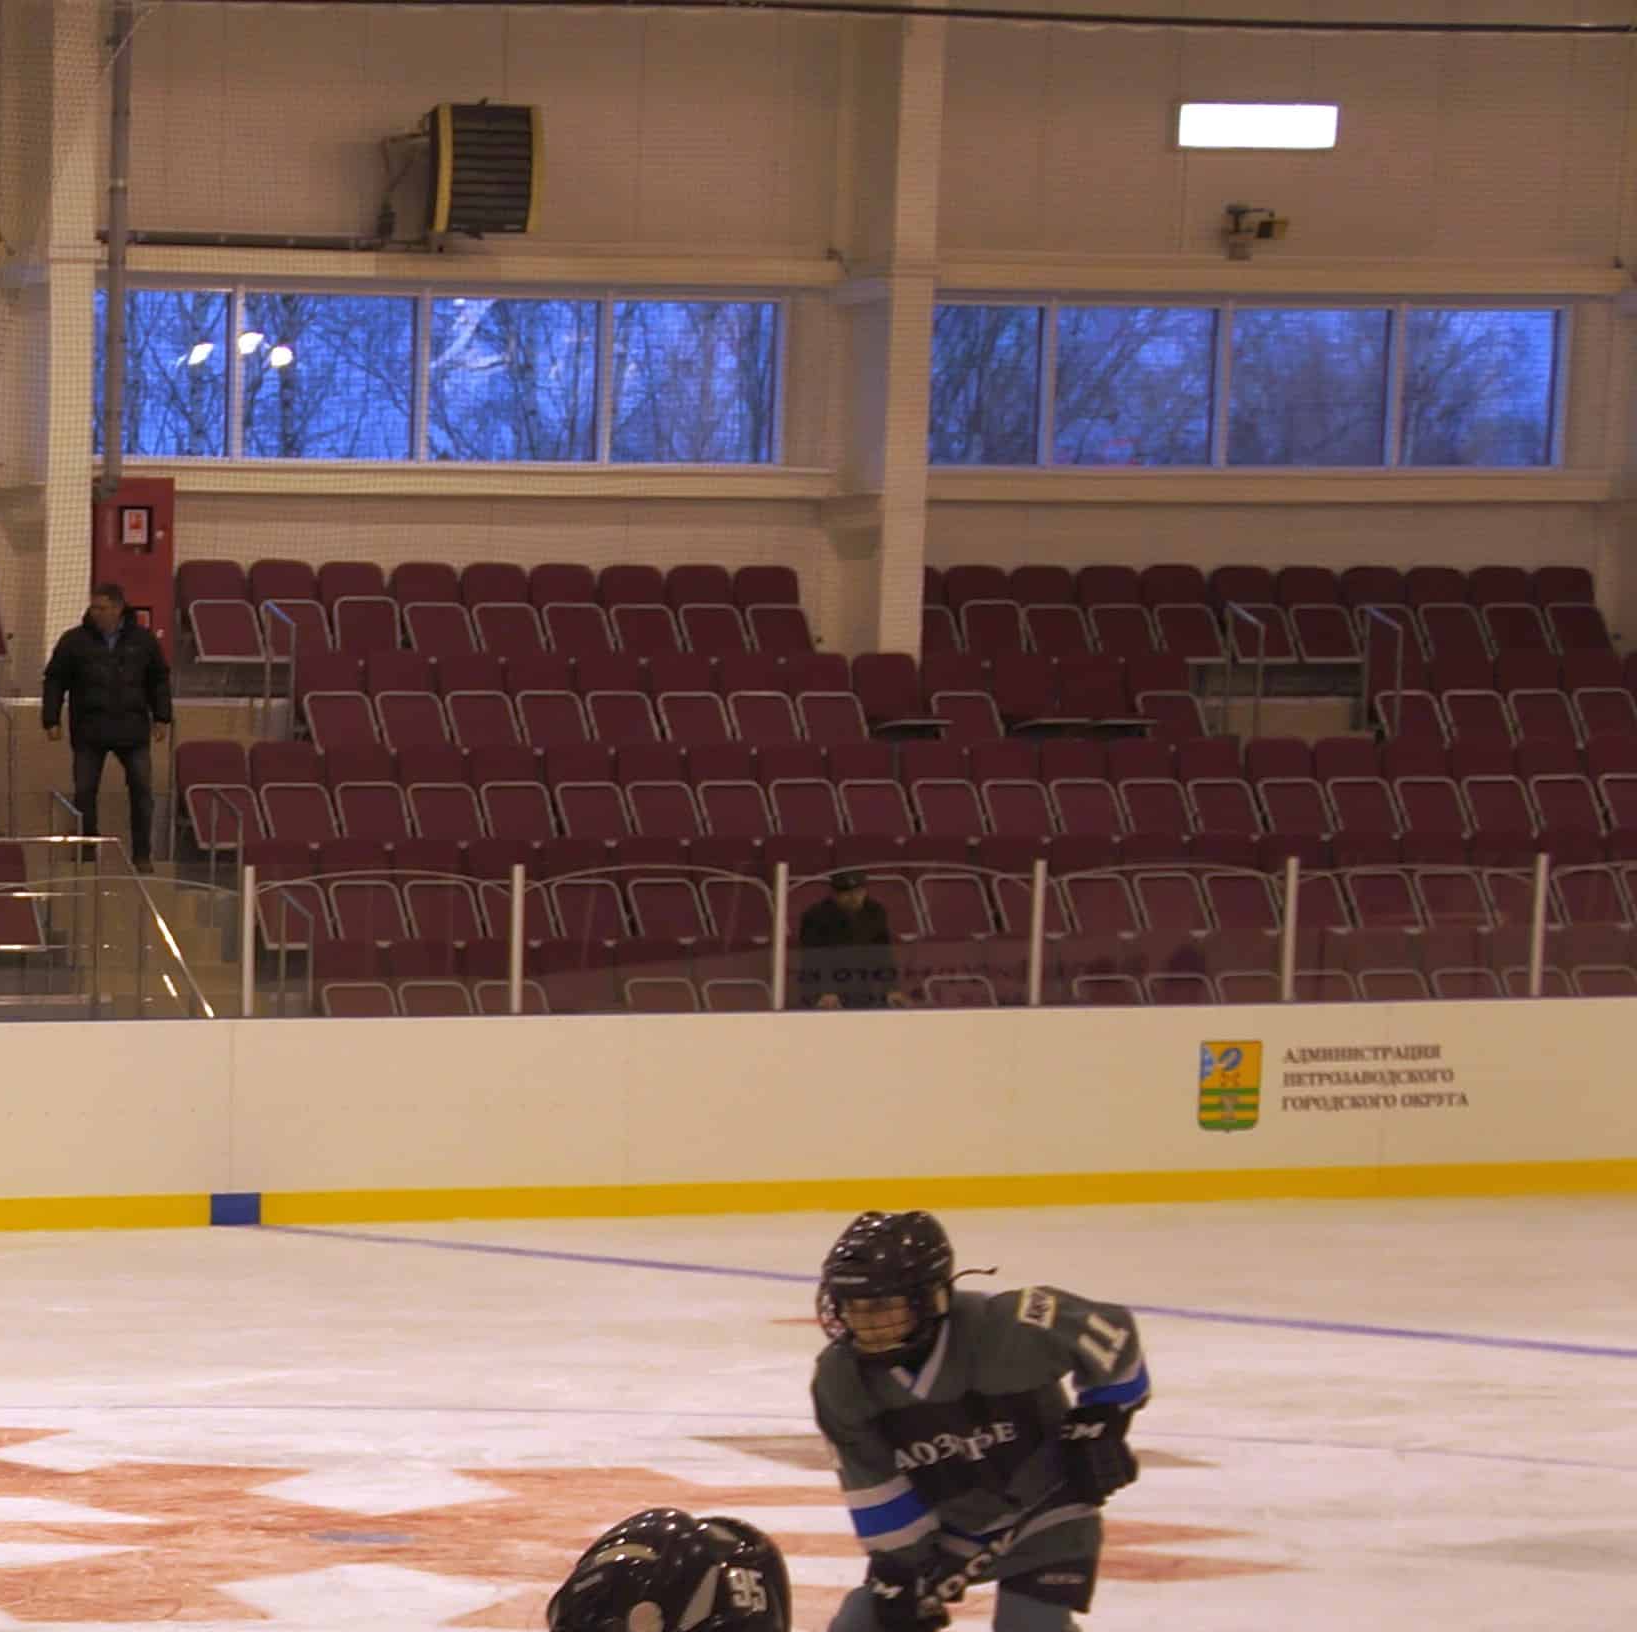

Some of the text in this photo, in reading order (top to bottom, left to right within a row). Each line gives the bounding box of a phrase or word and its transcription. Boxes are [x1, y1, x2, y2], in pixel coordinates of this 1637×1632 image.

[1282, 1091, 1469, 1111] ГОРОДСКОГО ОКРУГА
[1078, 1313, 1129, 1373] 11
